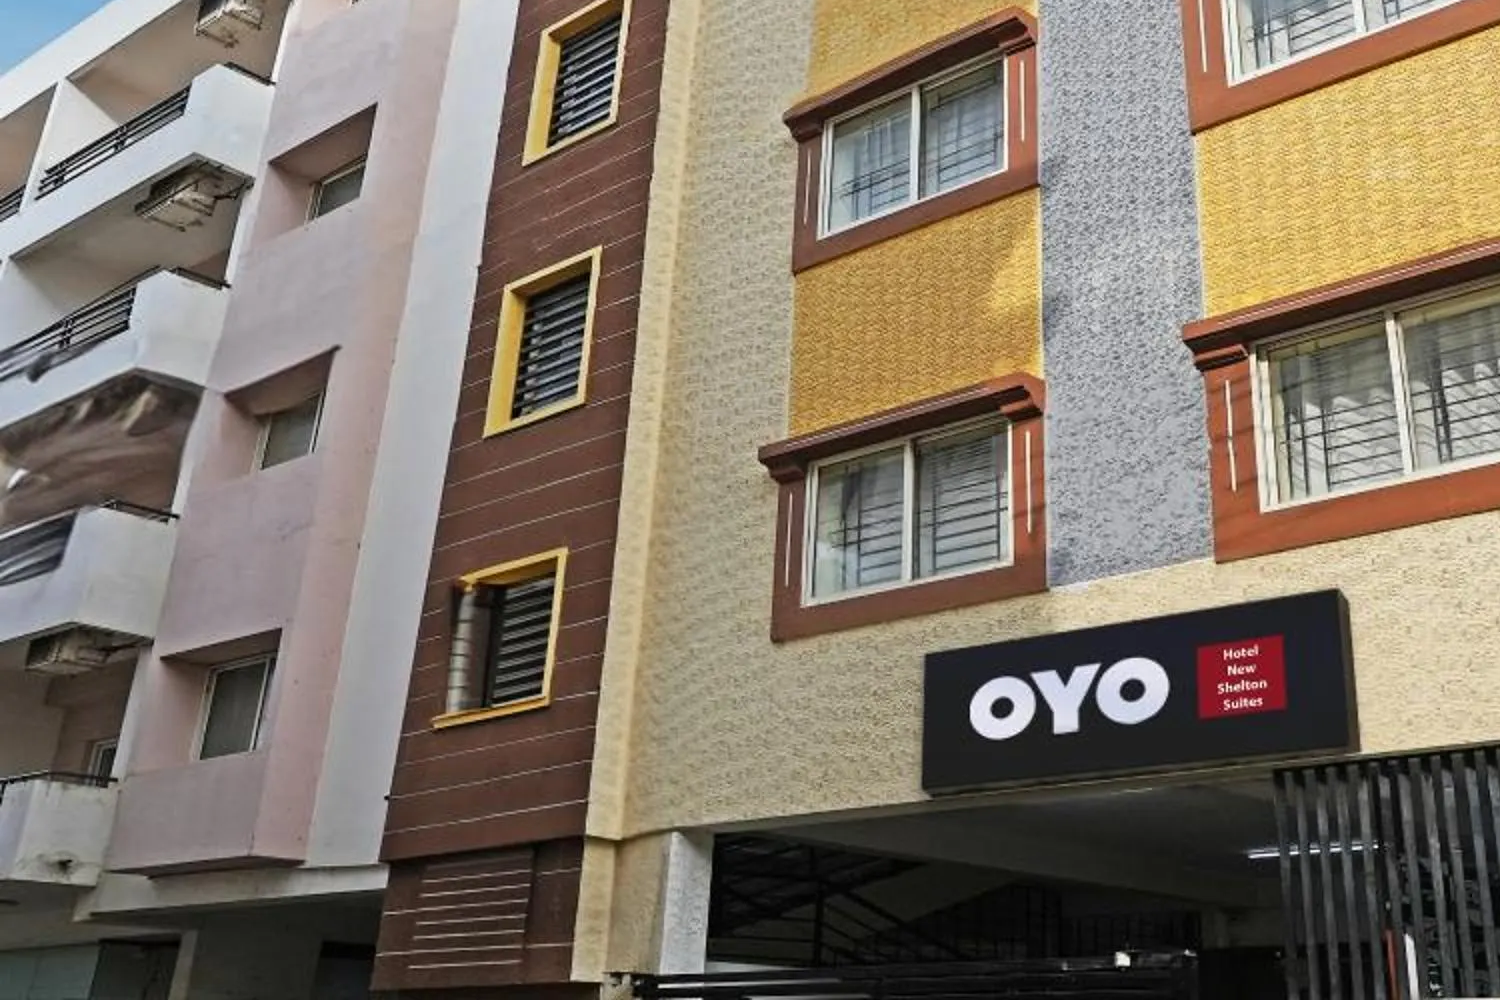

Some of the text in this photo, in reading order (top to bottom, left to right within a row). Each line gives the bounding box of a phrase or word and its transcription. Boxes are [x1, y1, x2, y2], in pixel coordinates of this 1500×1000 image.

[1223, 644, 1260, 660] Hotel
[1227, 663, 1257, 676] New
[1217, 679, 1268, 695] Shelton
[968, 656, 1171, 741] OYO
[1223, 696, 1263, 711] Suites
